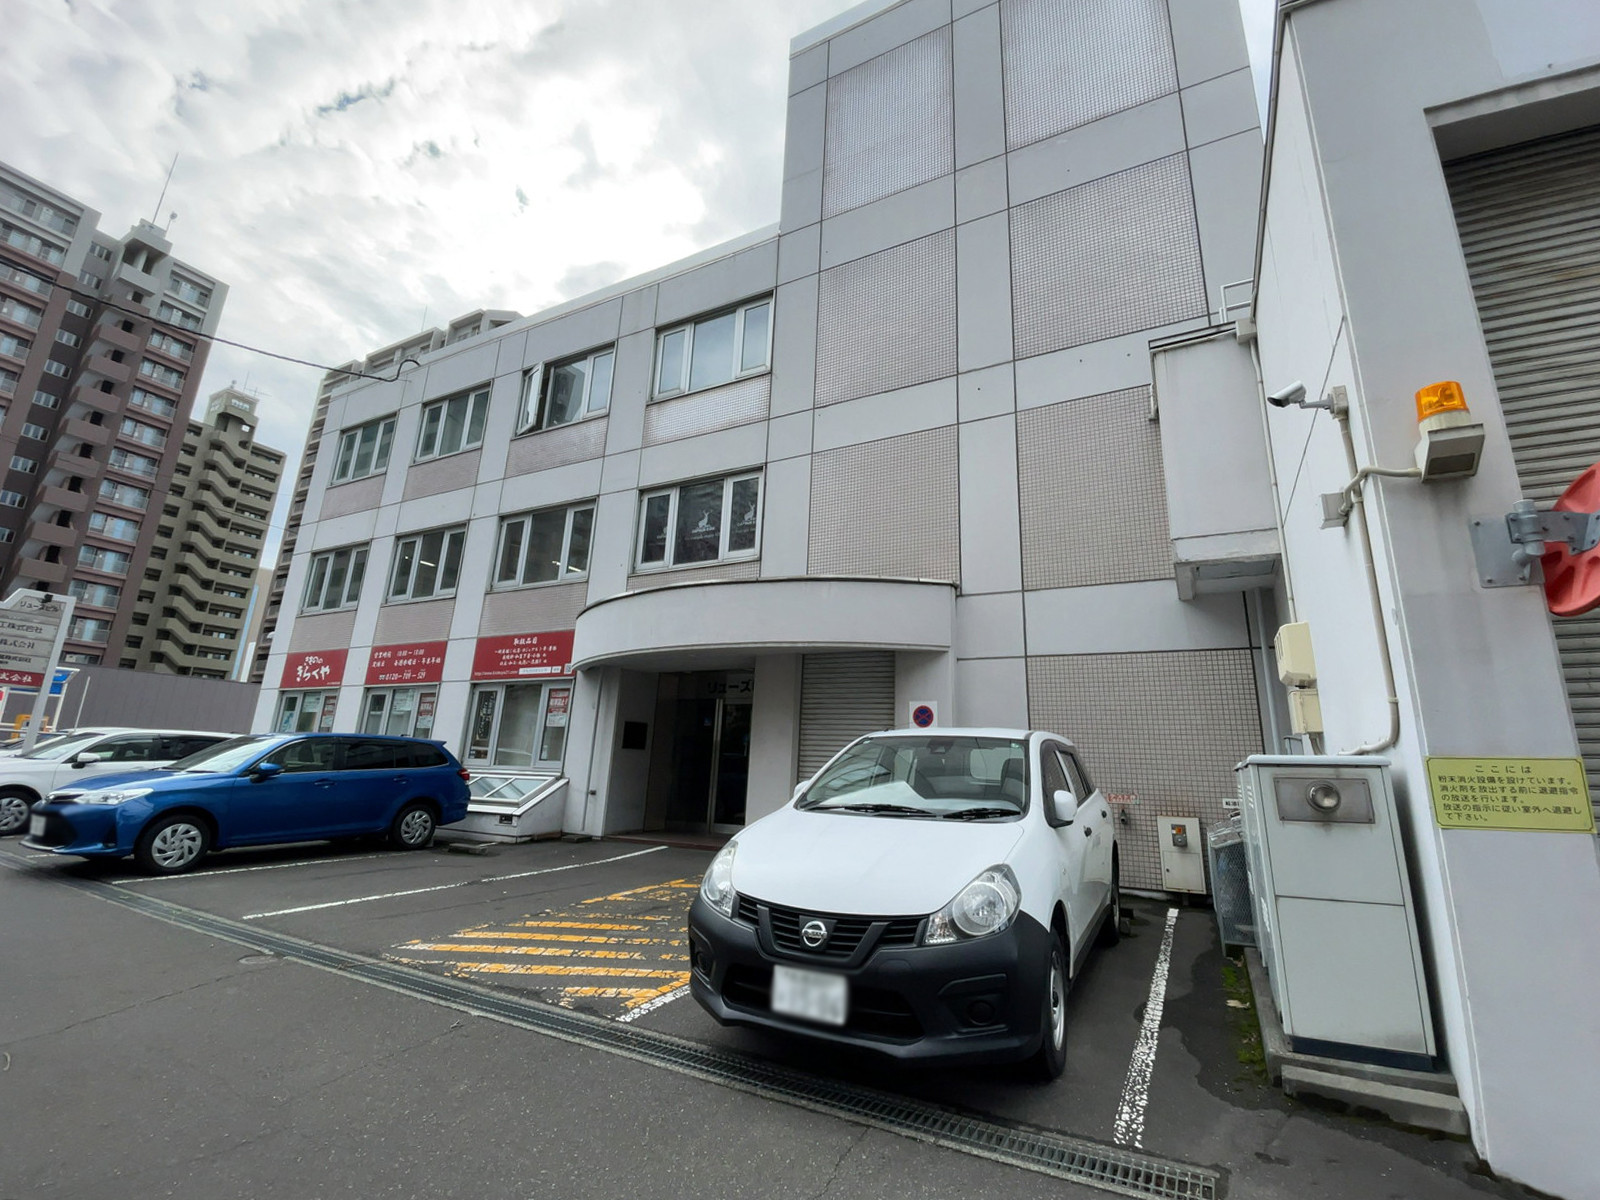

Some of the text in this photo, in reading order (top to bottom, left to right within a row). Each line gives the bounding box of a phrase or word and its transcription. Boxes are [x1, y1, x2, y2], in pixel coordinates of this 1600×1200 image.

[296, 664, 331, 683] きらくや
[707, 678, 754, 694] リューズ
[1475, 765, 1532, 774] ここには
[1438, 775, 1572, 786] 粉末消火設備を設けています。
[1440, 785, 1579, 796] 消火剤を放出する前に退避指令
[1441, 794, 1525, 804] の放送を行います。
[1443, 803, 1583, 815] 放送の指示に従い室外へ退避し
[1445, 812, 1488, 822] て下さい。
